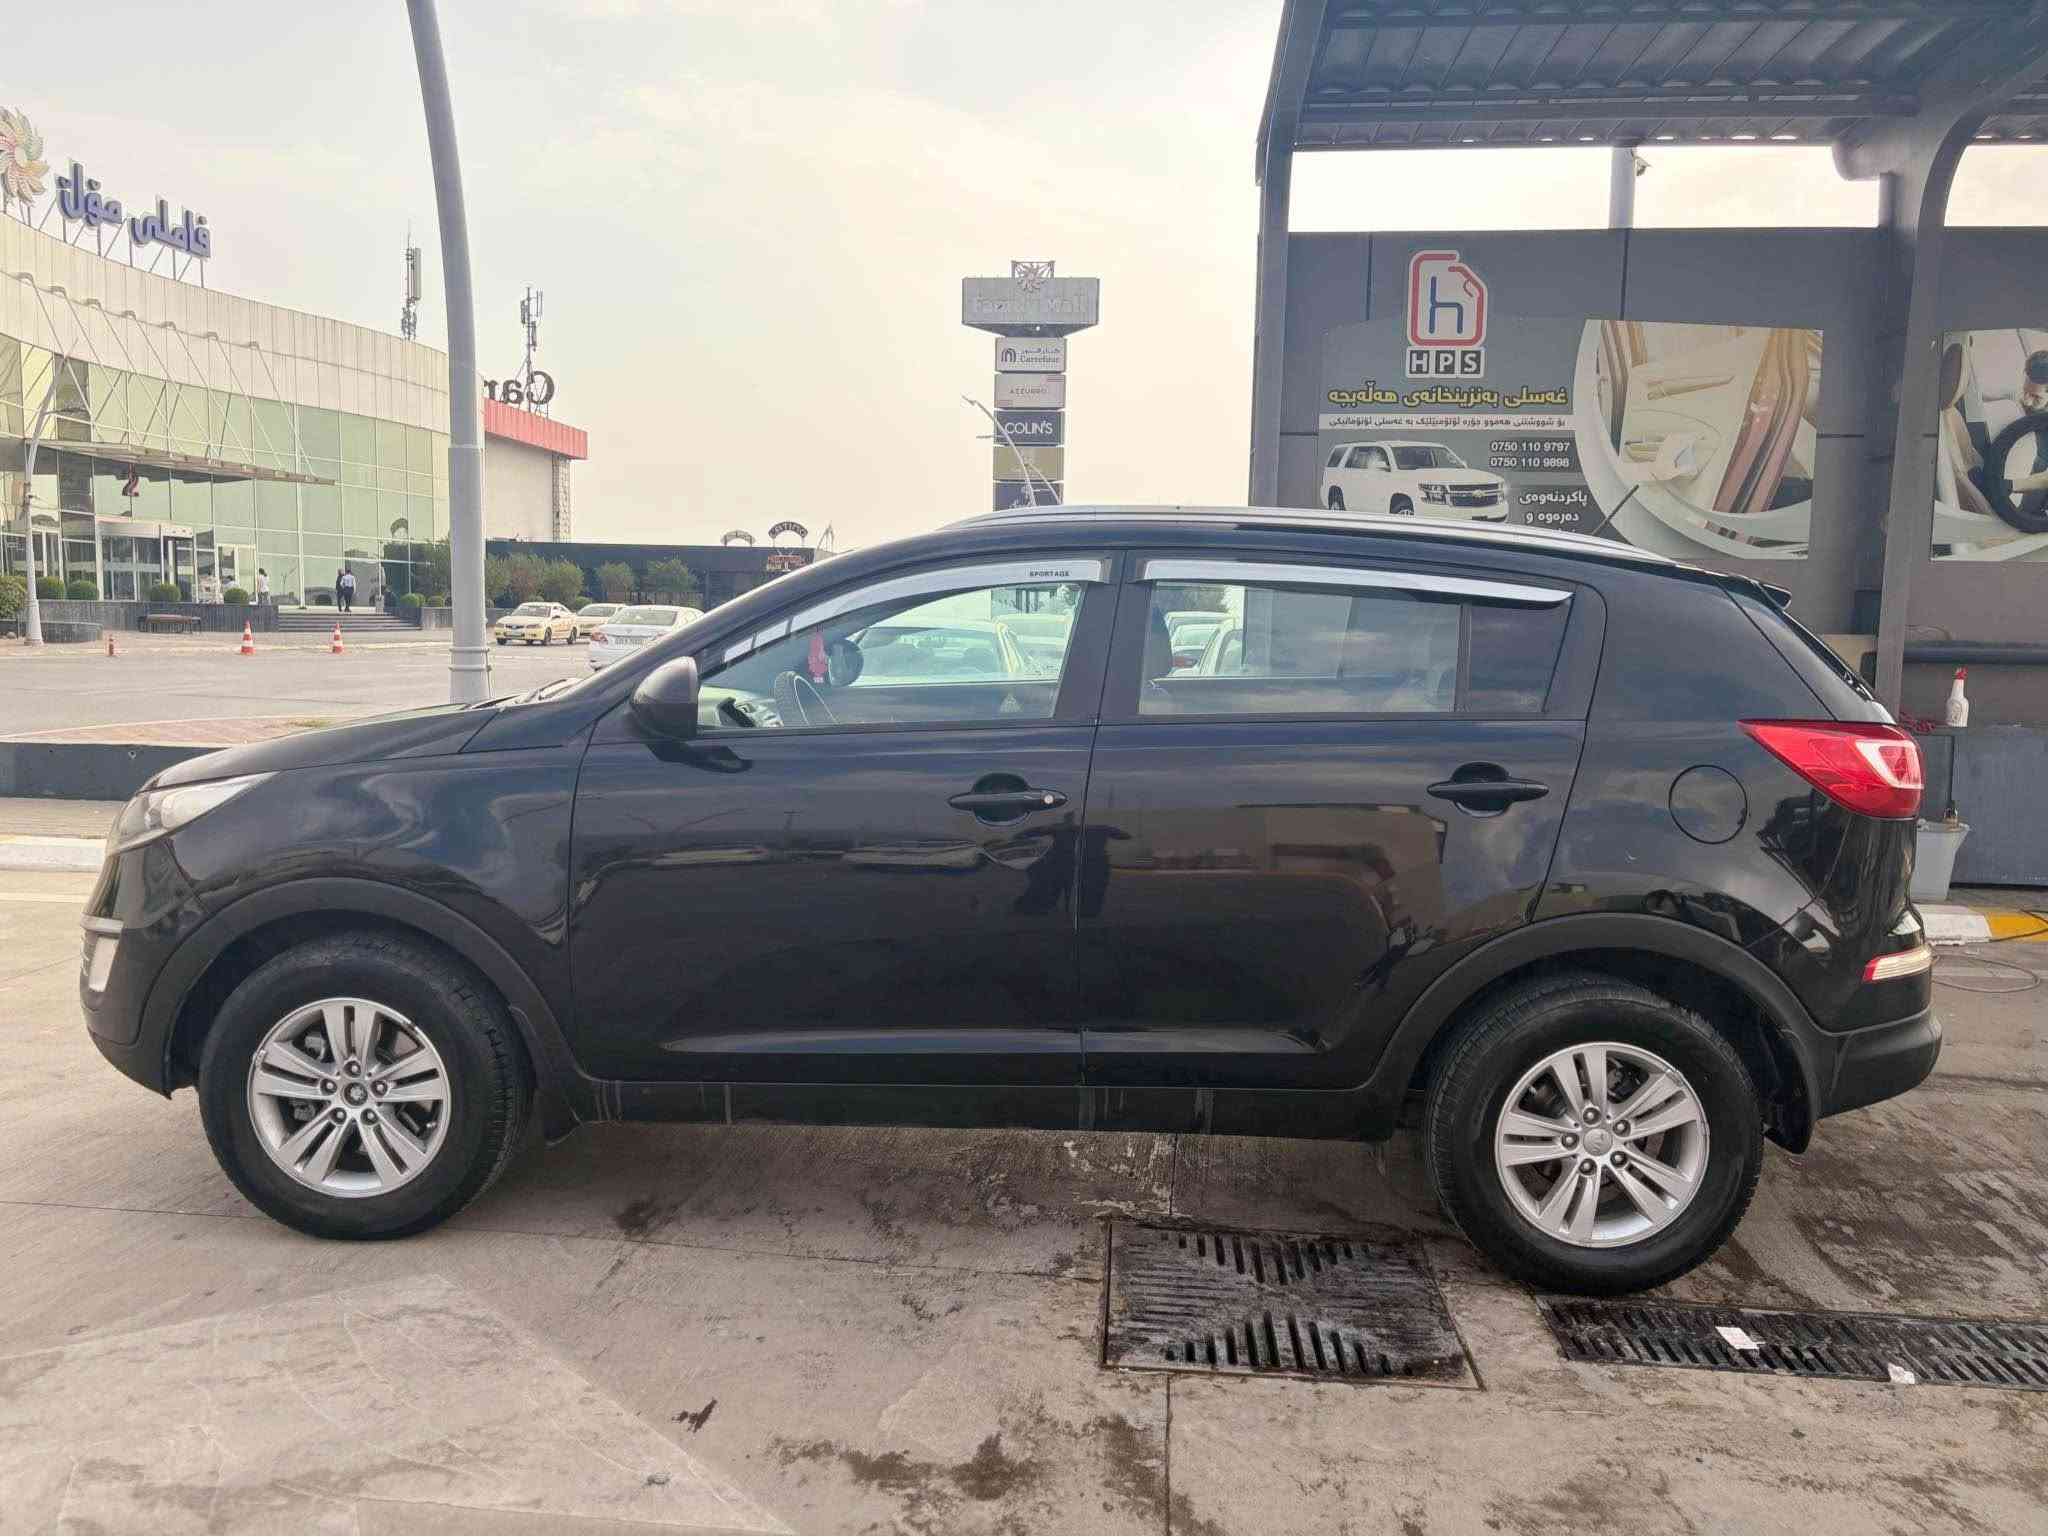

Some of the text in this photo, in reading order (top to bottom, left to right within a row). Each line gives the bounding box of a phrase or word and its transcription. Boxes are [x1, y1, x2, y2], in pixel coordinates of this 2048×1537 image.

[1409, 351, 1481, 374] HPS
[1004, 420, 1053, 434] COLIN'S
[1491, 441, 1570, 452] 0750 110 9797
[1490, 457, 1517, 467] 0750
[1521, 457, 1540, 467] 110
